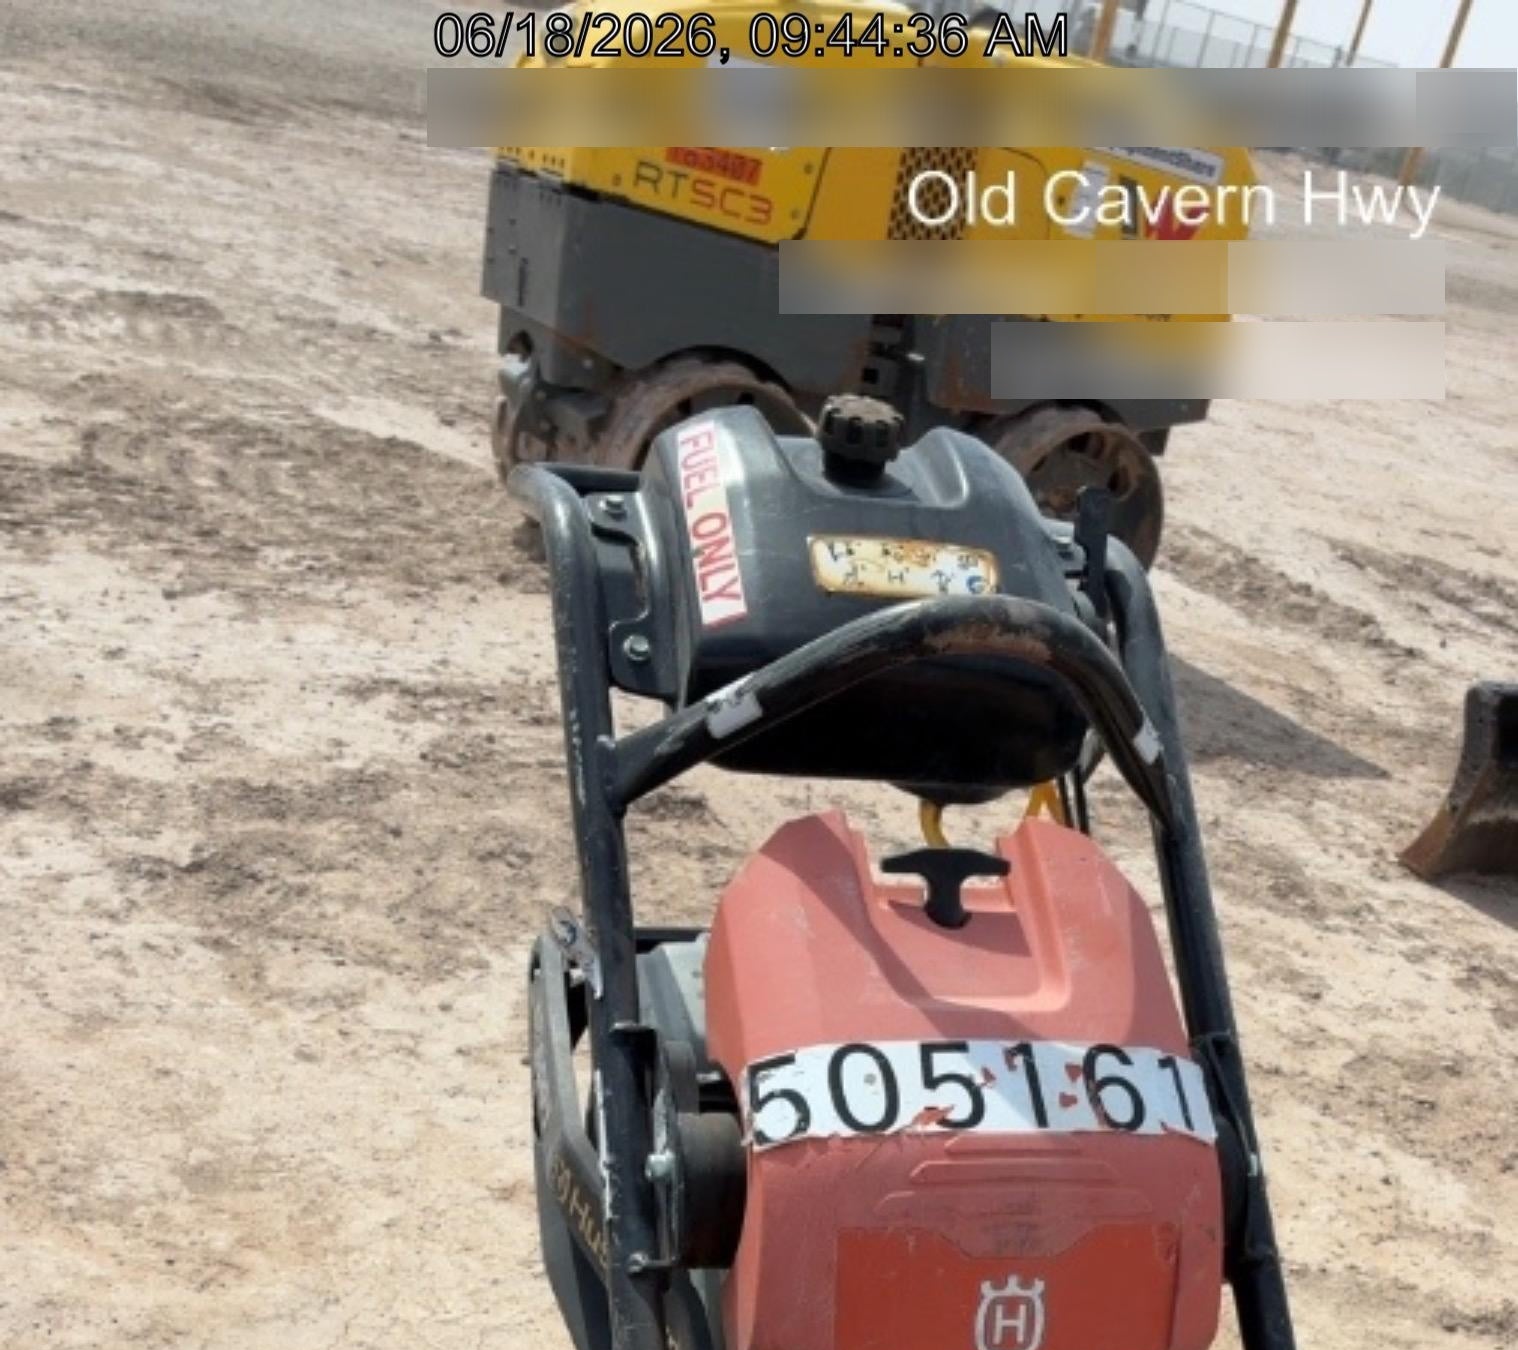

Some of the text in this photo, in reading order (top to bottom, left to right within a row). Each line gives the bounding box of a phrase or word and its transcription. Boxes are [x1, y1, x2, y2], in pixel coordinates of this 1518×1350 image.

[679, 430, 743, 604] FUEL ONLY
[746, 1041, 1197, 1145] 505161
